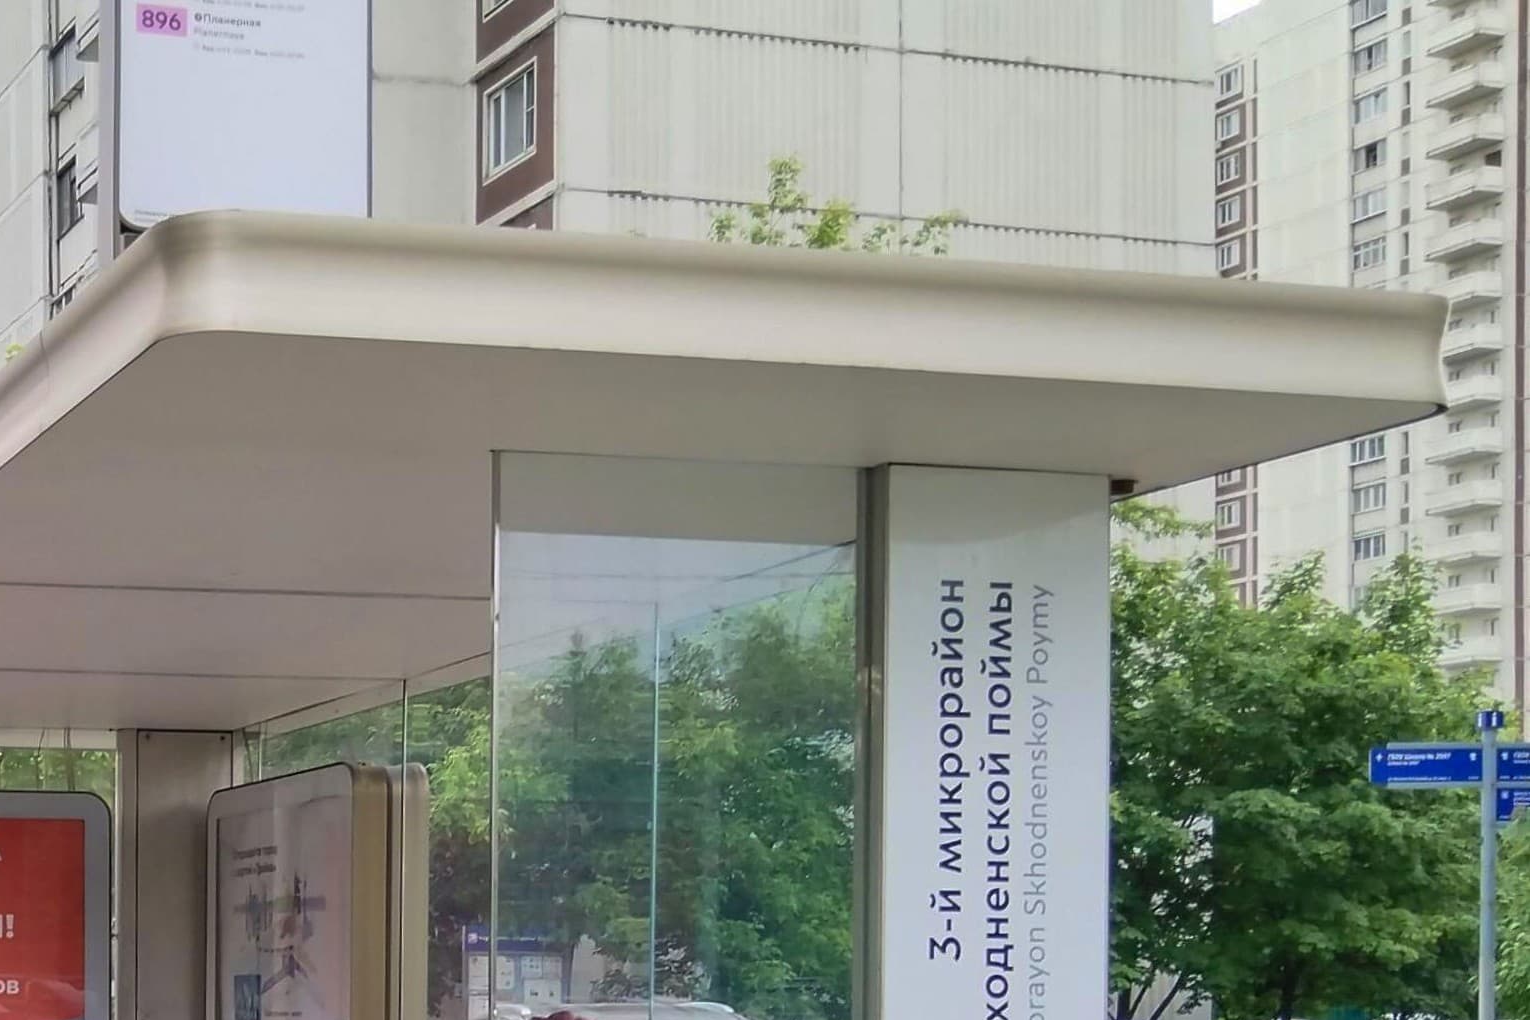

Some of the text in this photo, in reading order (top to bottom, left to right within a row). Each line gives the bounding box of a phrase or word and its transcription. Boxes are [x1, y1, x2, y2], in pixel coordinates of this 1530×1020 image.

[142, 10, 182, 31] 896
[203, 12, 261, 28] Планерная
[980, 581, 1014, 736] поймы
[1026, 583, 1055, 685] Poymy
[929, 578, 971, 962] 3-й микрорайон
[1023, 694, 1054, 916] Skhodnenskoy
